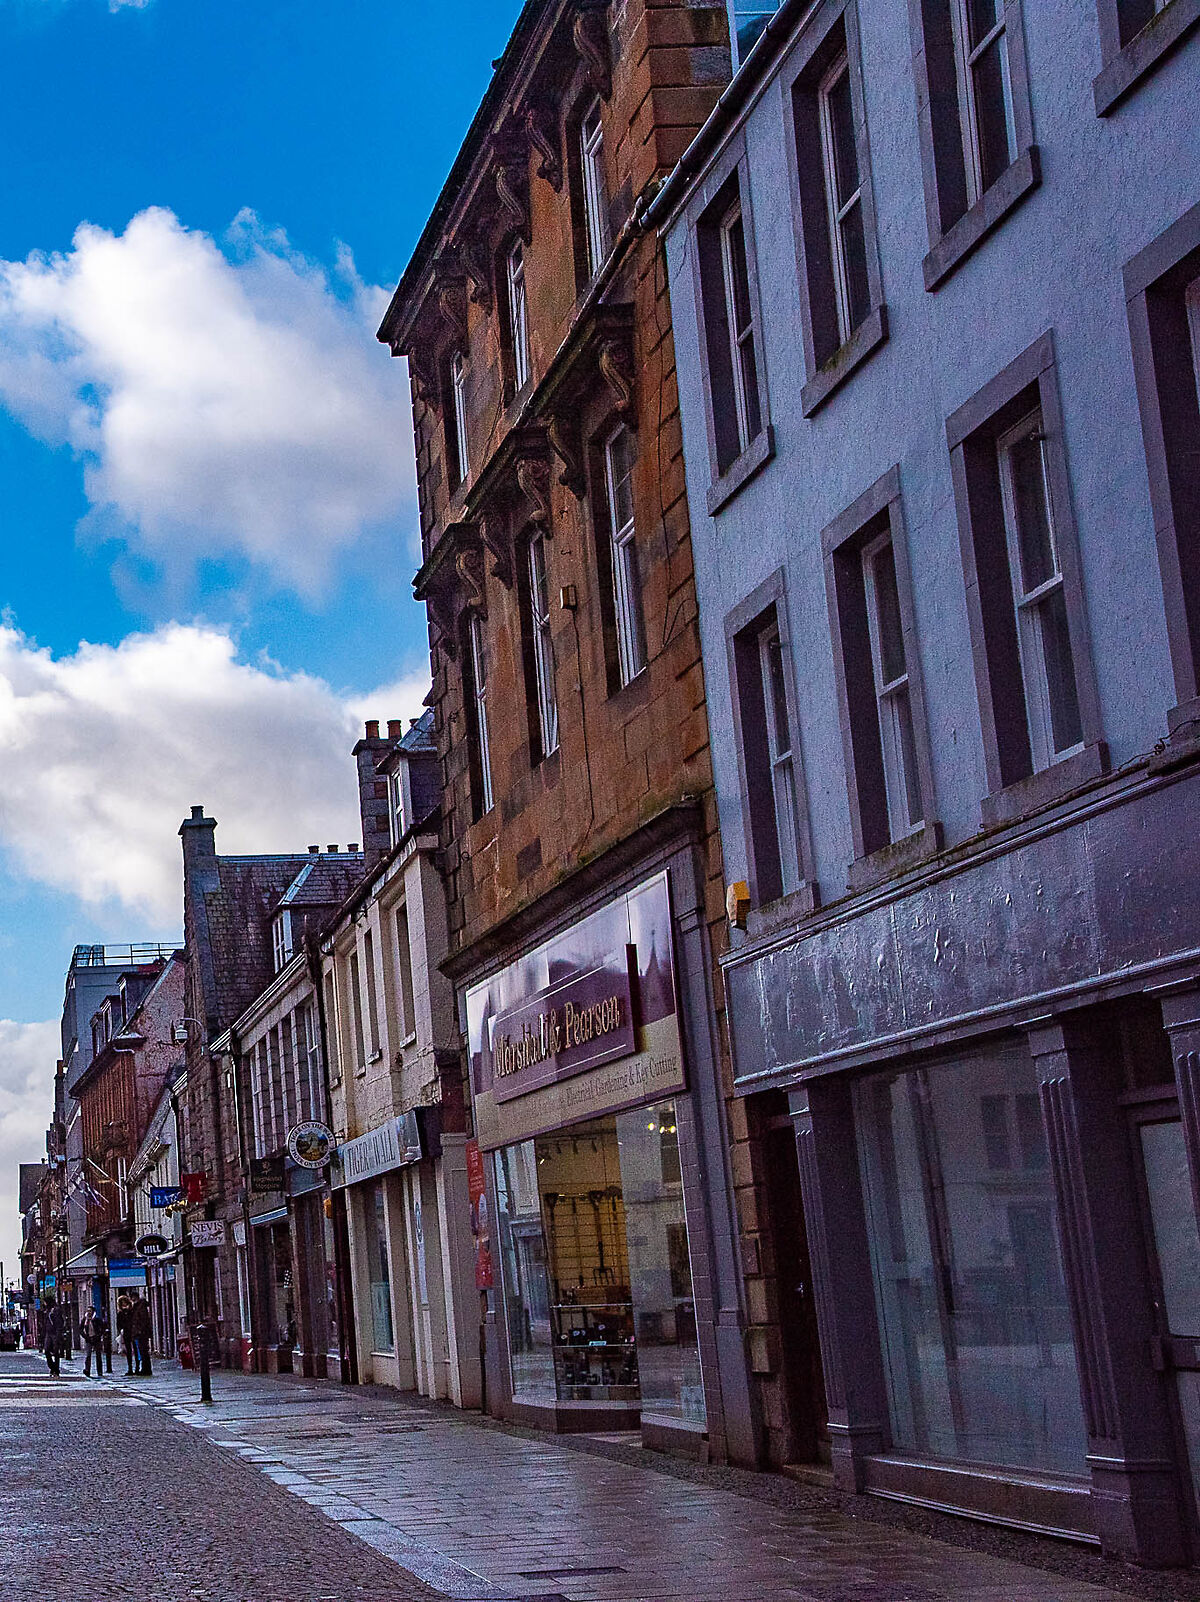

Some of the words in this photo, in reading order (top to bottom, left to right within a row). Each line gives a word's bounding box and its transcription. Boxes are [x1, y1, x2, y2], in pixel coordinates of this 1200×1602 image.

[493, 1012, 551, 1079] Marshall
[549, 1008, 560, 1056] &
[564, 995, 620, 1050] Pearson
[635, 1061, 648, 1085] Key
[650, 1053, 678, 1079] Cutting
[347, 1141, 370, 1177] TIGER
[372, 1129, 396, 1167] WALL
[192, 1221, 224, 1233] NEVIS
[143, 1244, 161, 1254] HILL
